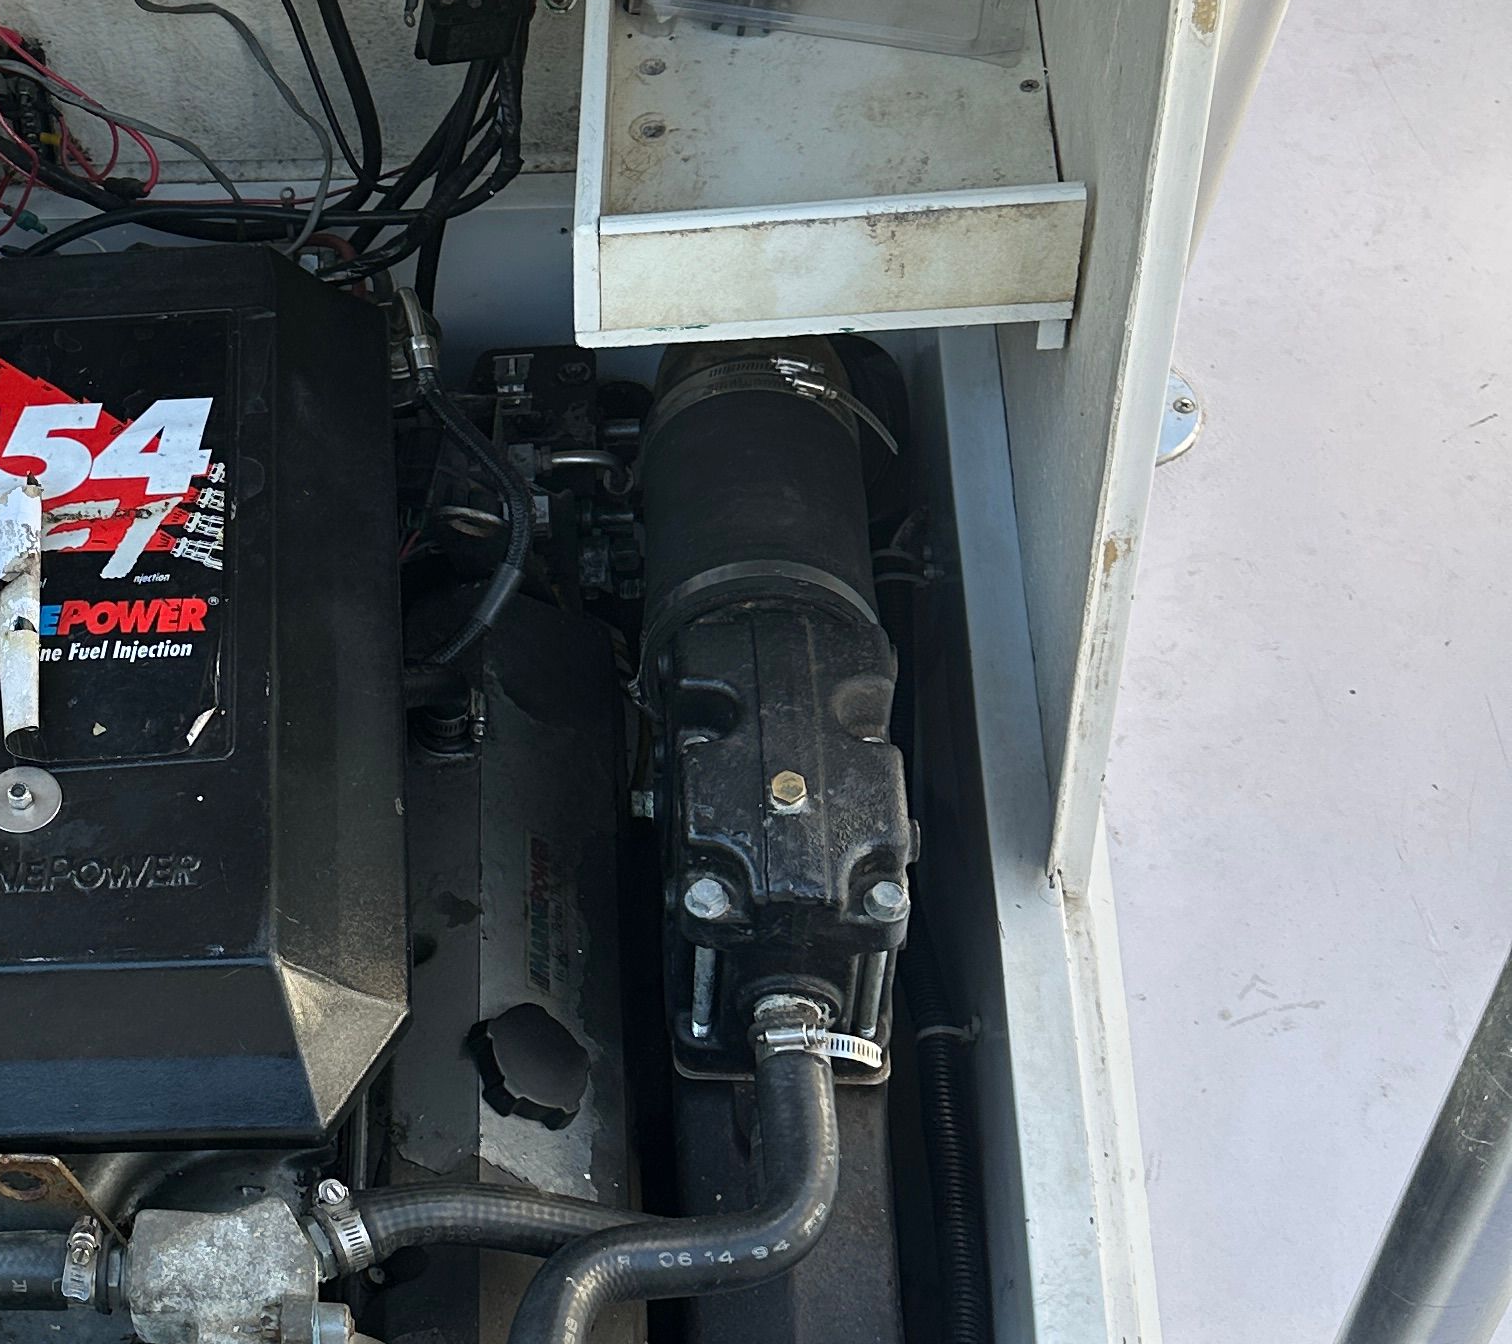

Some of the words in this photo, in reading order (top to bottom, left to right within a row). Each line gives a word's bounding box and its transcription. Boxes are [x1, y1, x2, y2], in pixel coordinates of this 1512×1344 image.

[133, 573, 170, 585] njection
[39, 598, 208, 636] EPOWER
[68, 640, 109, 661] Fuel
[112, 640, 193, 663] Injection
[657, 1252, 693, 1268] 06
[751, 1239, 791, 1260] 94
